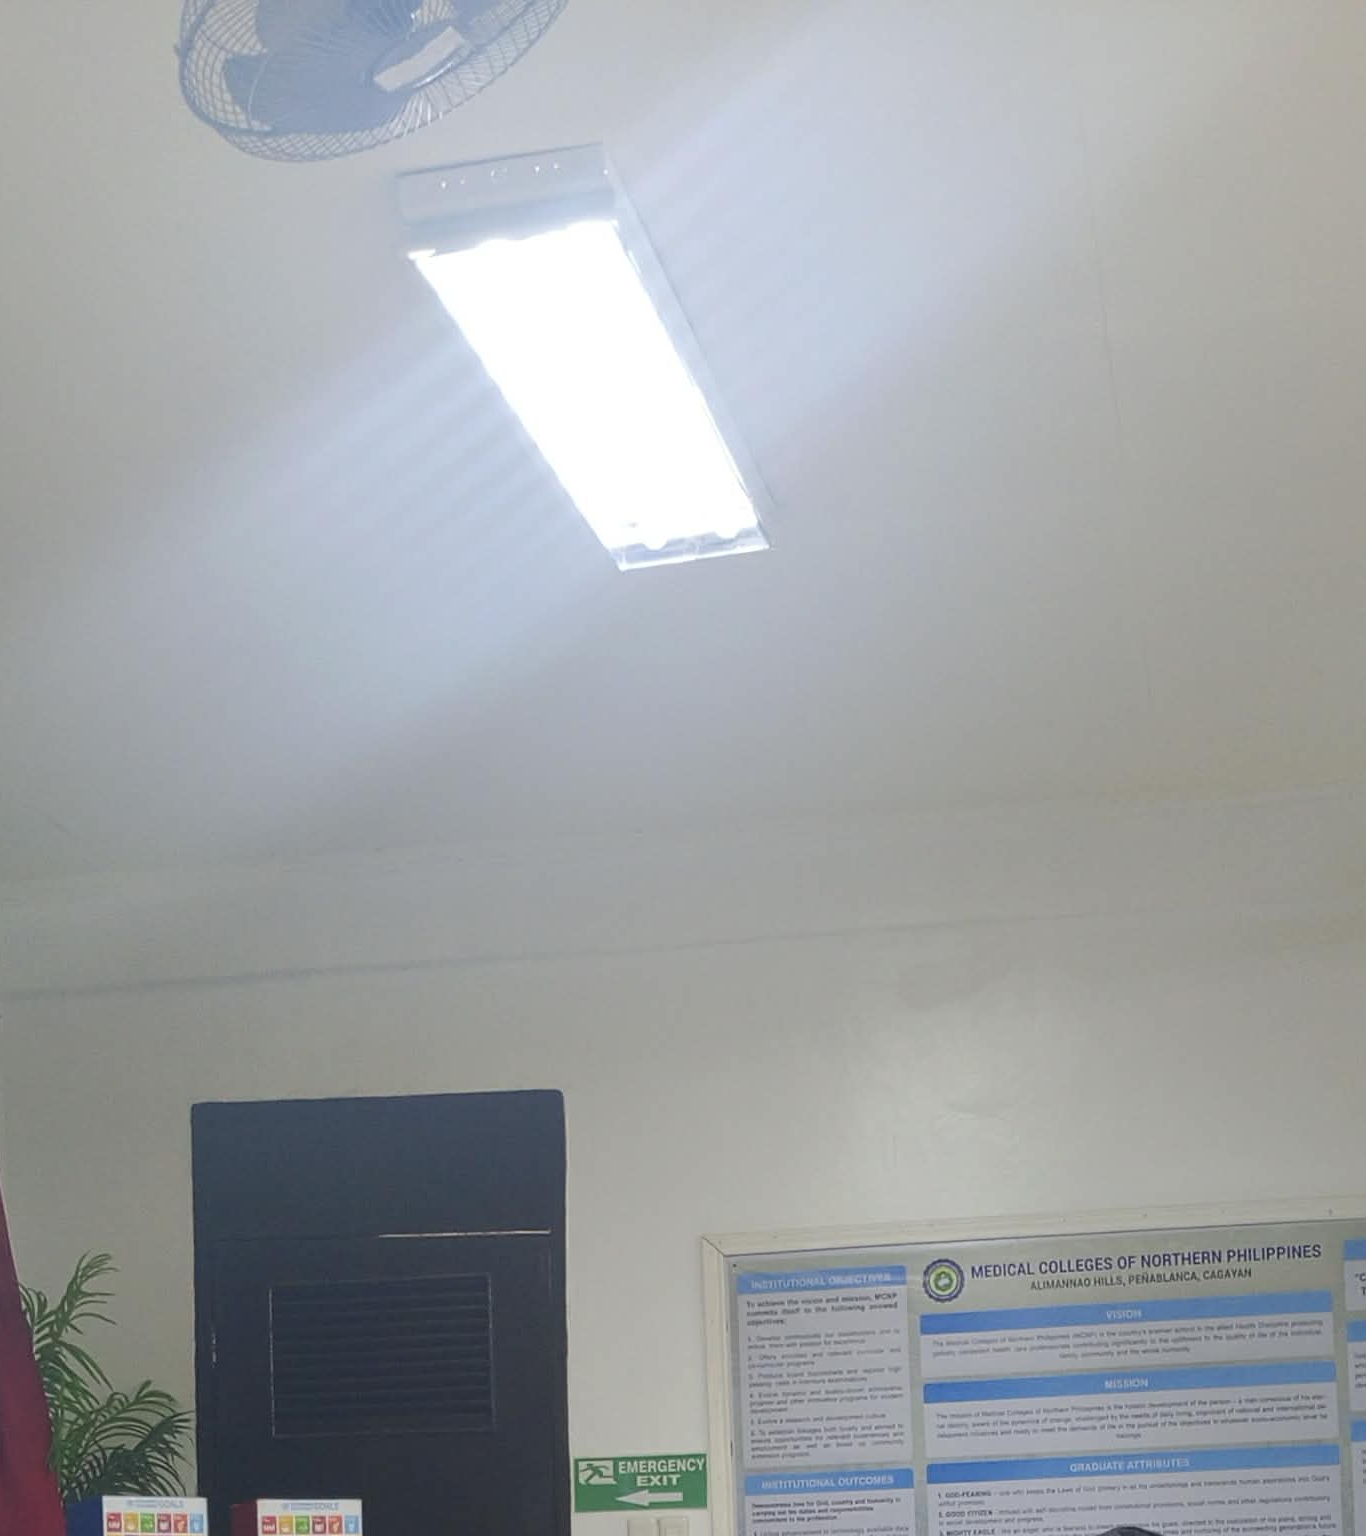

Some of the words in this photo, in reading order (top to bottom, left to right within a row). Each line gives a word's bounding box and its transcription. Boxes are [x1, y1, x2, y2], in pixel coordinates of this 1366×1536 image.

[971, 1261, 1034, 1279] MEDICAL
[1039, 1257, 1113, 1275] COLLEGES
[1117, 1255, 1135, 1270] OF
[1140, 1250, 1221, 1268] NORTHERN
[1227, 1244, 1322, 1263] PHILIPPINES
[751, 1277, 825, 1289] INSTITUTIONAL
[828, 1274, 892, 1286] OBJECTIVES
[1030, 1278, 1091, 1291] ALIMANNAO
[1094, 1275, 1125, 1288] HILLS,
[1203, 1268, 1252, 1282] CAGAYAN
[1106, 1310, 1142, 1320] VISION
[1105, 1378, 1149, 1390] MISSION
[619, 1458, 705, 1474] EMERGENCY
[1069, 1461, 1125, 1473] GRADUATE
[1126, 1457, 1190, 1471] ATTRIBUTES
[637, 1474, 681, 1487] EXIT
[762, 1478, 835, 1490] INSTITUTIONAL
[838, 1475, 893, 1487] OUTCOMES
